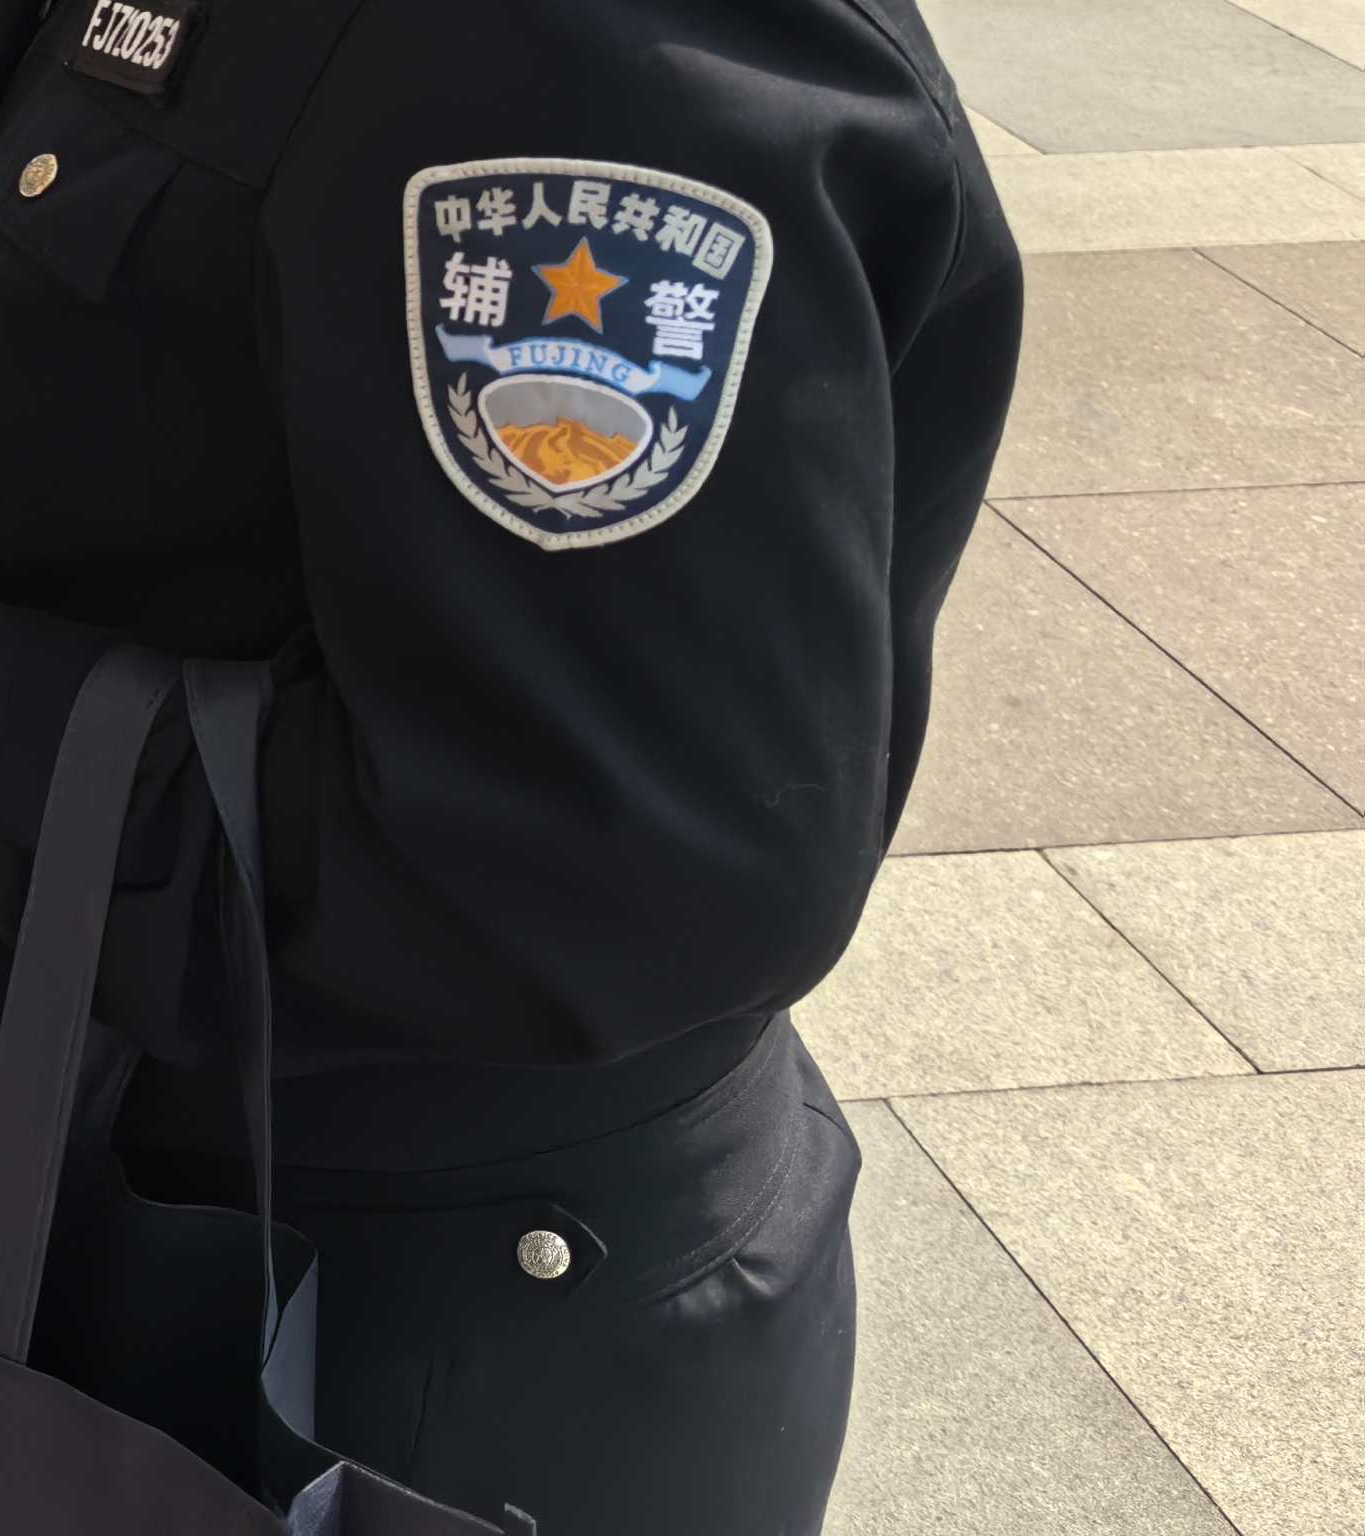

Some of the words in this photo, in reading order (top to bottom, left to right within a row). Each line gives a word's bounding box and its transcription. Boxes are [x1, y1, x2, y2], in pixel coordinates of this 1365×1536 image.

[434, 180, 746, 280] 中华人民共和国
[439, 251, 513, 328] 辅
[644, 280, 720, 361] 警
[508, 346, 633, 385] FUJING
